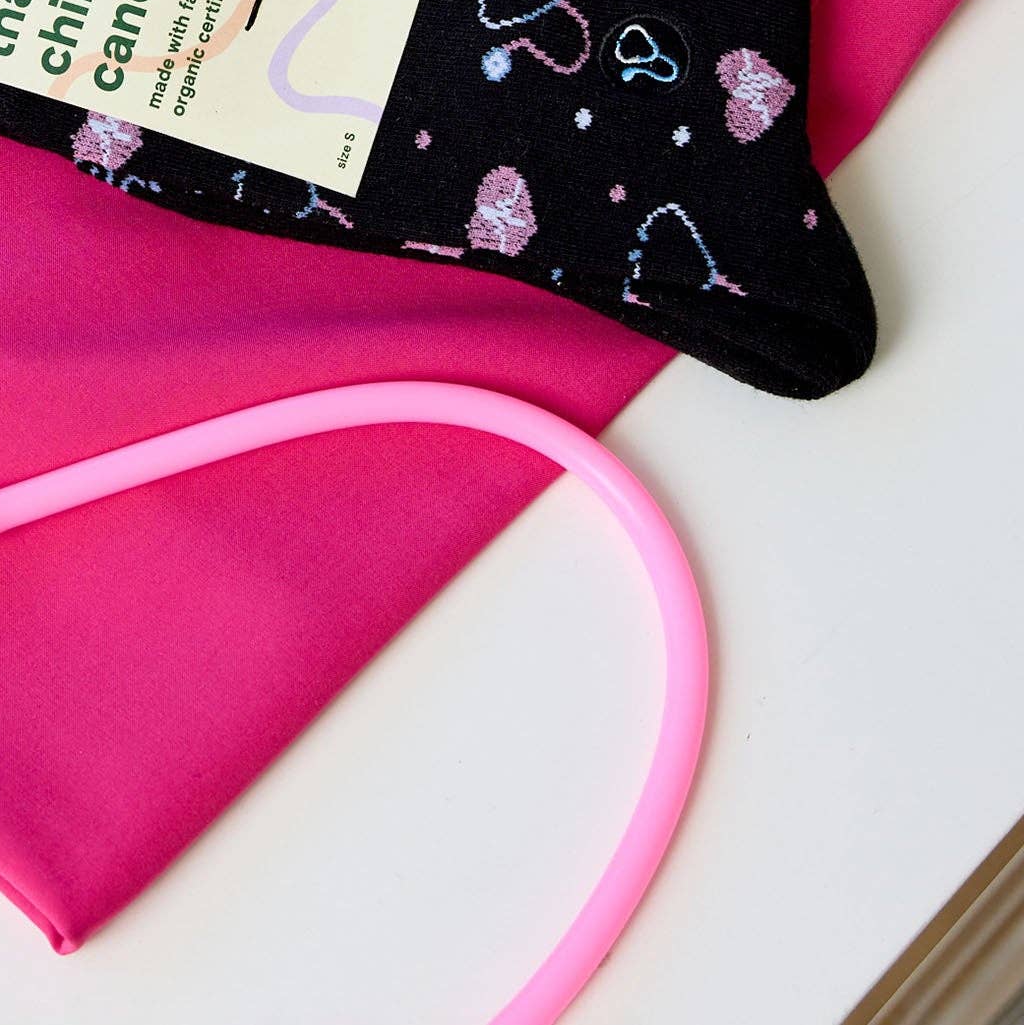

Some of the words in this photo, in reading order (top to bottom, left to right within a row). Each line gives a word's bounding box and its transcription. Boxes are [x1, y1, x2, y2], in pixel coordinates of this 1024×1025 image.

[149, 58, 175, 109] made
[168, 15, 190, 53] with
[174, 47, 205, 116] organic
[336, 145, 352, 169] size
[344, 132, 356, 142] S
